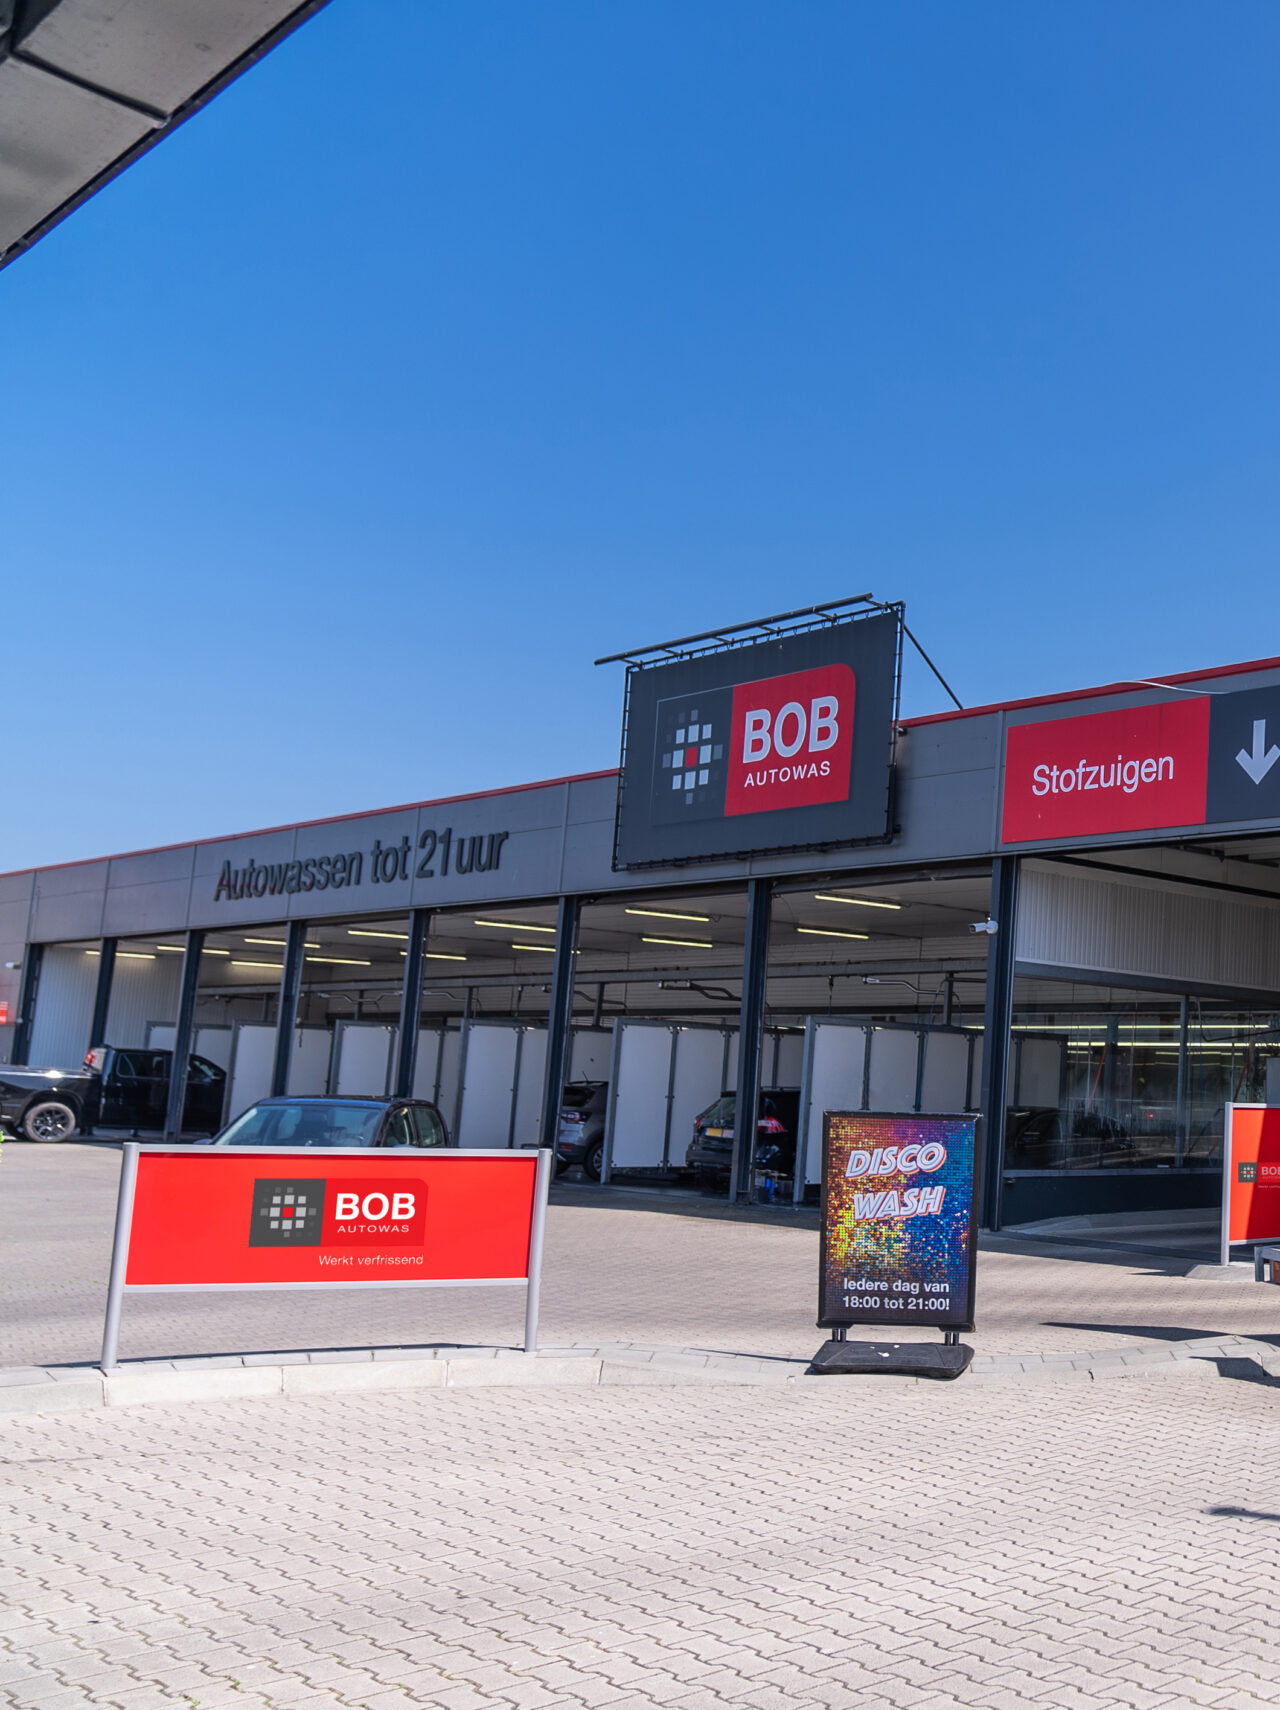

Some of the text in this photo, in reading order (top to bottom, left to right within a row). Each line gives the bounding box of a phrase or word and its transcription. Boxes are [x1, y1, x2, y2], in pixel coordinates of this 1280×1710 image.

[742, 695, 839, 764] BOB
[744, 760, 831, 788] AUTOWAS
[1031, 754, 1174, 796] Stofzuigen
[214, 850, 363, 902] Autowassen
[370, 835, 412, 884] tot
[415, 827, 453, 879] 21
[844, 1142, 948, 1179] DISCO
[335, 1192, 416, 1221] BOB
[853, 1185, 947, 1222] WASH
[337, 1224, 410, 1233] AUTOWAS
[318, 1254, 424, 1266] Werkt verfrissend
[843, 1277, 950, 1294] Iedere dag van
[843, 1295, 951, 1311] 18:00 tot 21:00!
